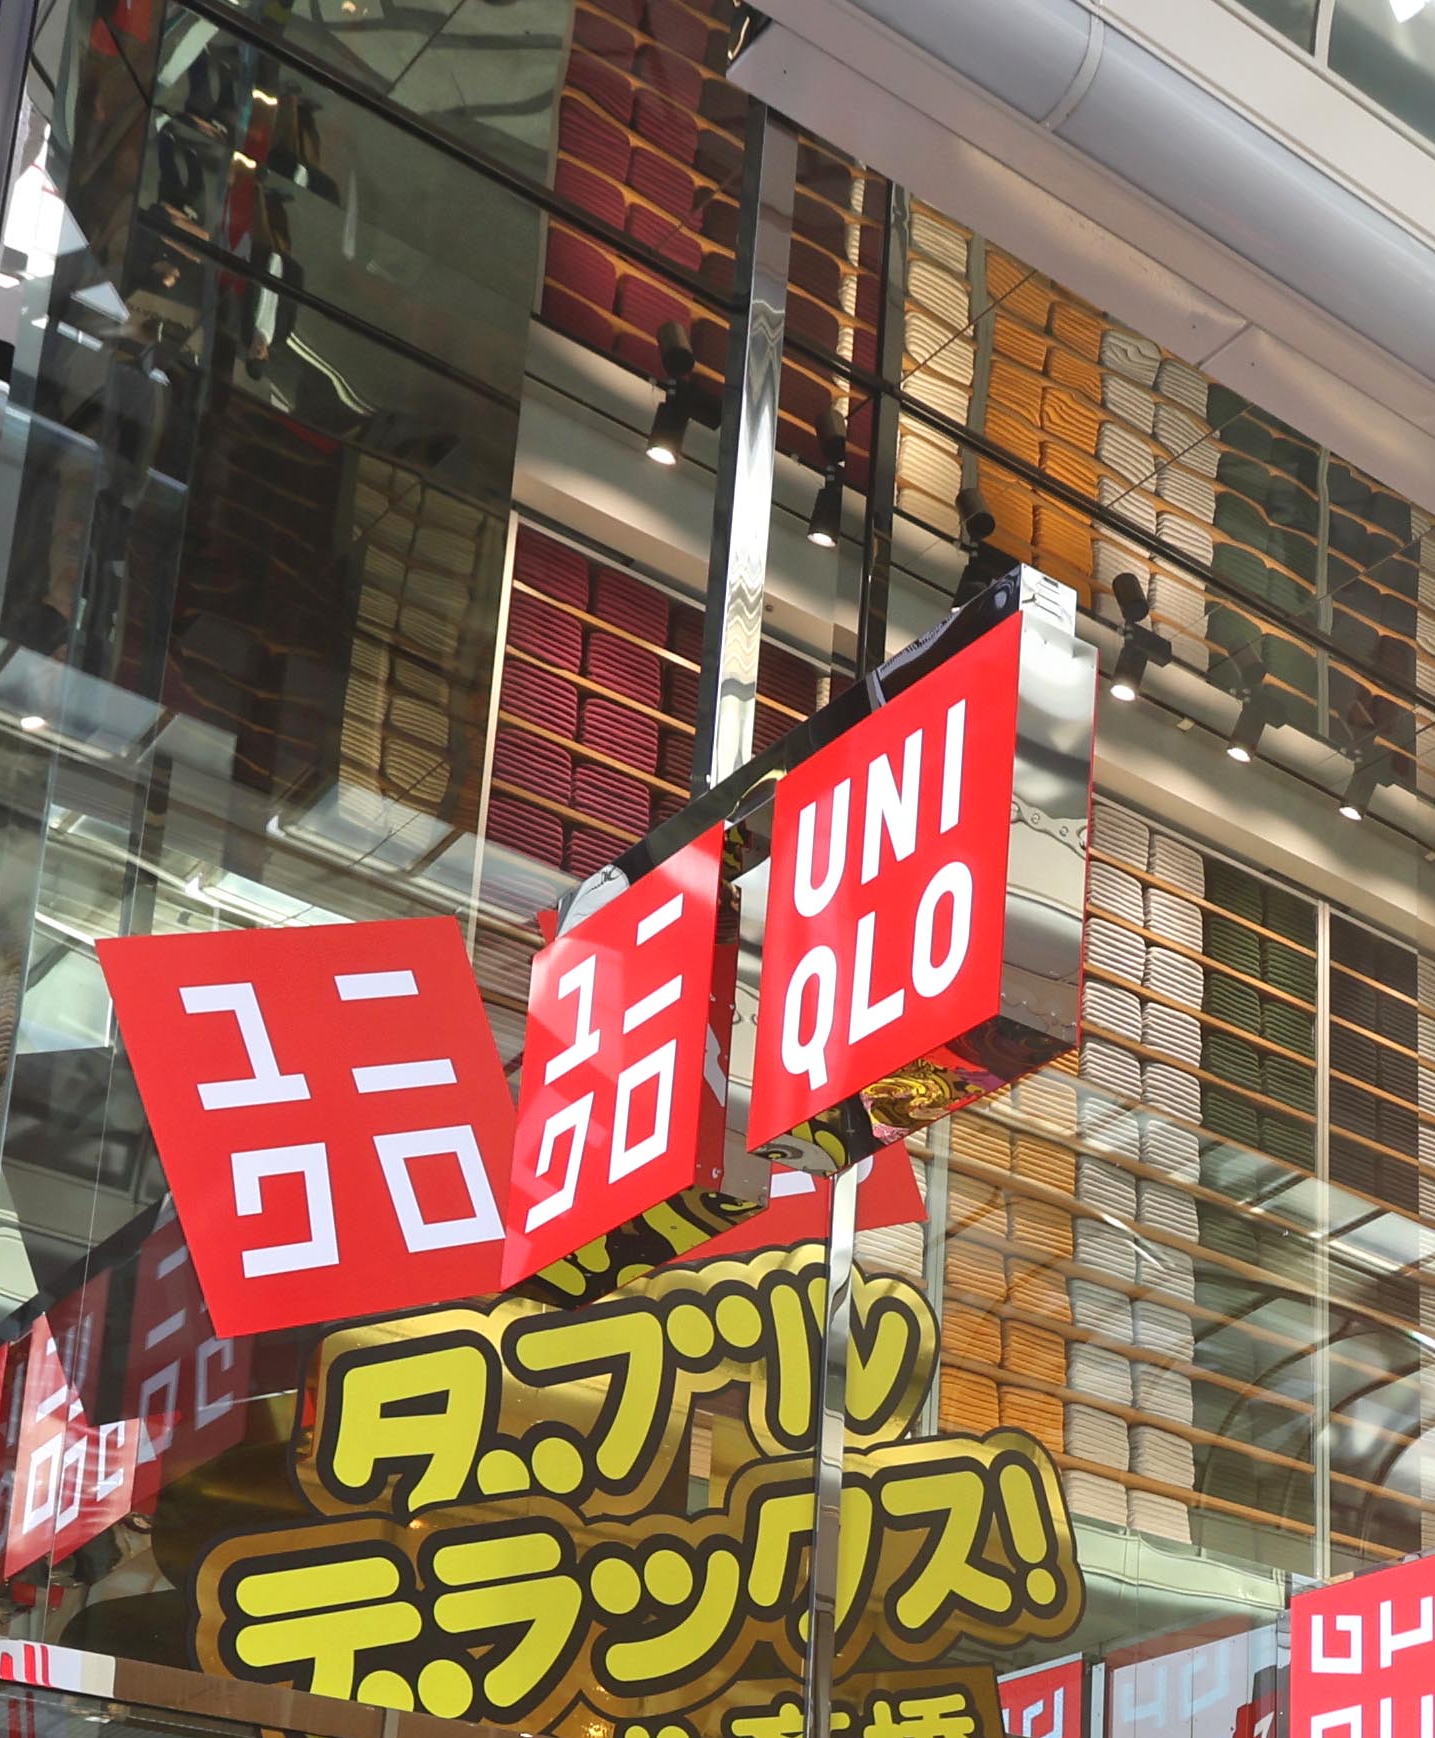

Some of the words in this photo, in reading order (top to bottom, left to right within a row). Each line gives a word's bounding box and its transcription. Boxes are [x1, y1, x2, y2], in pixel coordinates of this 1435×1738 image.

[790, 698, 968, 919] UNI
[178, 969, 456, 1113] ユニ
[544, 894, 686, 1086] ユニ
[779, 860, 973, 1093] QLO
[232, 1126, 508, 1278] クロ
[523, 1039, 678, 1233] クロ
